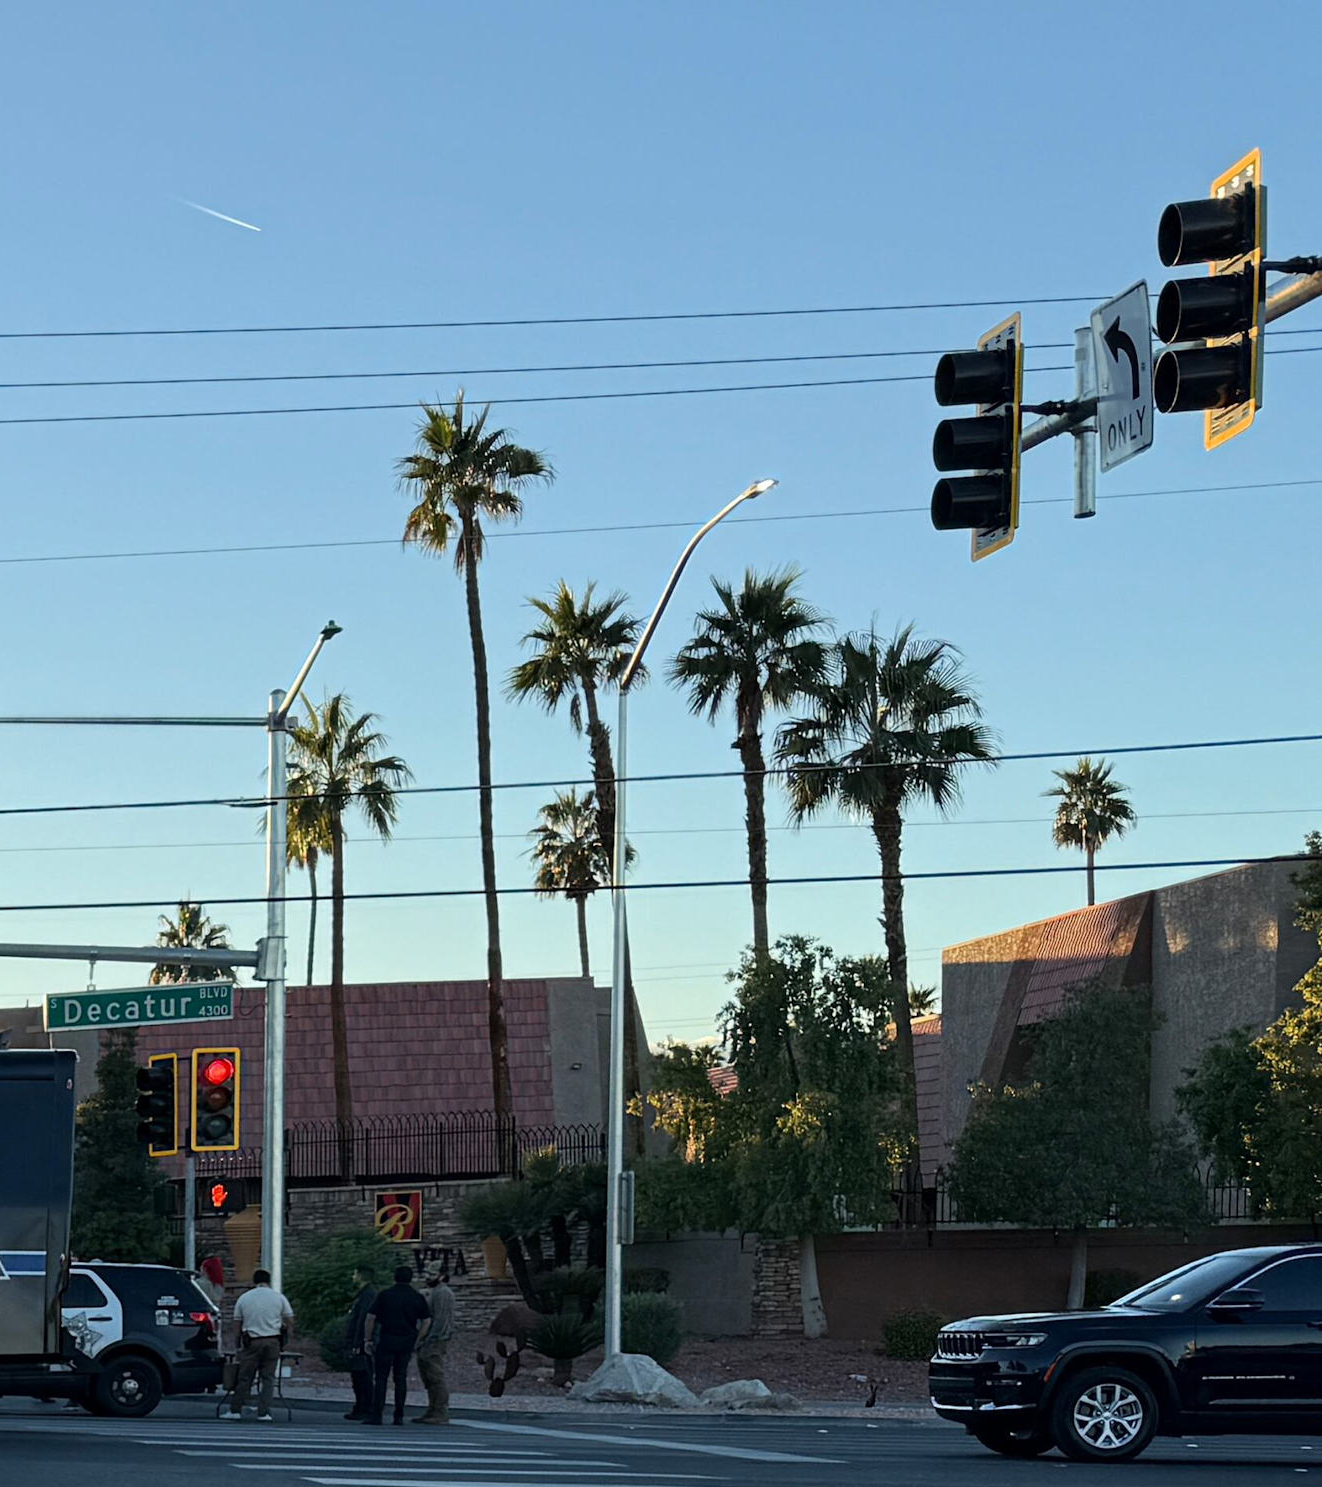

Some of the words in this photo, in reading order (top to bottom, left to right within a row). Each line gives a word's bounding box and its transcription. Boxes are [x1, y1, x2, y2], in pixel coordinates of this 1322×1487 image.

[1108, 405, 1146, 451] ONLY
[50, 999, 58, 1009] S
[64, 995, 192, 1024] Decatur
[199, 987, 228, 999] BLVD
[199, 1005, 229, 1017] 4300
